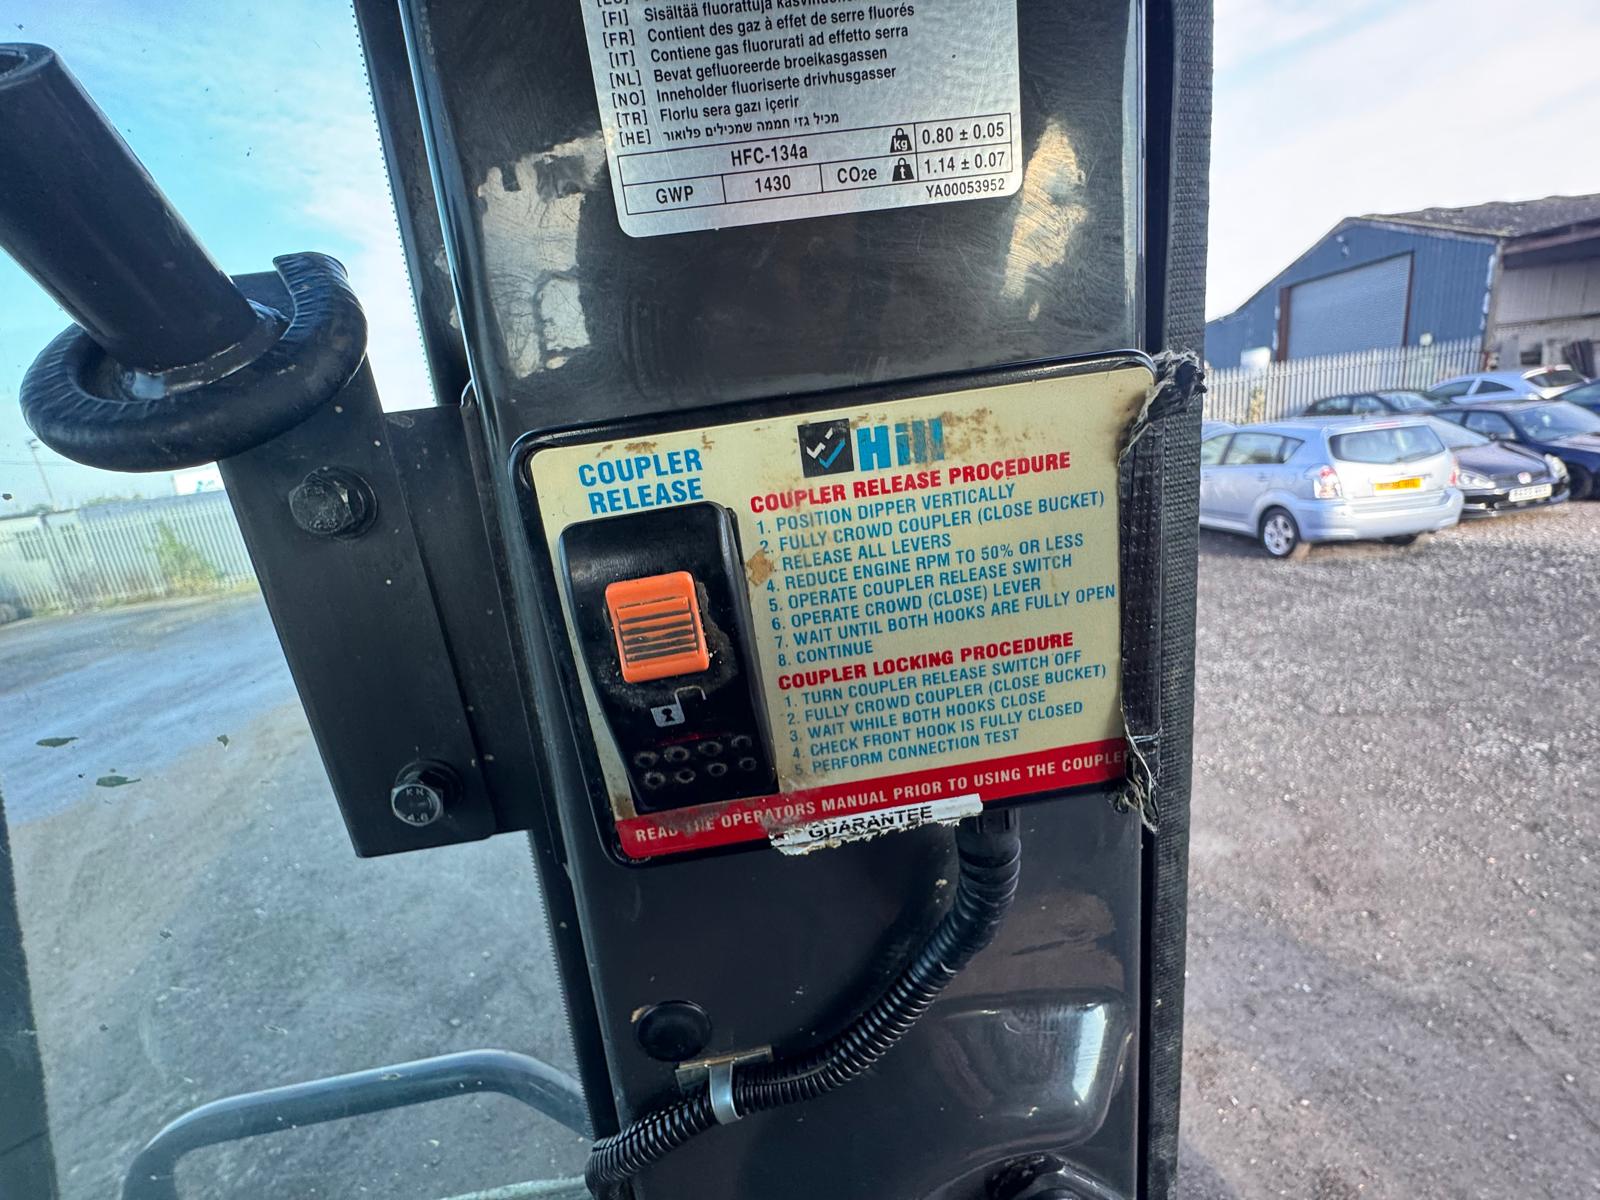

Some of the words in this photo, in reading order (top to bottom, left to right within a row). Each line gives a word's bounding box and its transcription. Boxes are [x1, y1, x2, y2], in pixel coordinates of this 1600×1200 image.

[601, 9, 629, 29] [FI]
[643, 2, 699, 22] Sisältää
[702, 0, 773, 16] fluorattuja
[602, 28, 635, 49] [FR]
[647, 23, 706, 43] Contient
[708, 20, 734, 37] des
[736, 20, 761, 37] gaz
[764, 15, 773, 31] à
[776, 12, 807, 30] effet
[810, 10, 827, 26] de
[830, 9, 865, 24] serre
[867, 1, 915, 20] fluorés
[608, 49, 636, 69] [IT]
[650, 45, 711, 63] Contiene
[714, 43, 739, 60] gas
[742, 32, 804, 54] fluorurati
[808, 30, 825, 47] ad
[828, 27, 871, 45] effetto
[874, 25, 908, 40] serra
[609, 69, 642, 89] [NL]
[653, 66, 693, 83] Bevat
[695, 56, 780, 82] gefluoreerde
[783, 48, 887, 69] broeikasgassen
[611, 89, 646, 109] [NO]
[656, 82, 728, 103] Inneholder
[730, 75, 800, 95] fluoriserte
[803, 67, 896, 87] drivhusgasser
[615, 108, 648, 129] [TR]
[659, 105, 699, 122] Florlu
[702, 104, 731, 118] sera
[764, 94, 799, 114] içerir
[922, 127, 954, 145] 0.80
[973, 122, 1005, 140] 0.05
[618, 128, 652, 148] [HE]
[731, 144, 808, 166] HFC-134a
[755, 174, 791, 193] 1430
[925, 157, 956, 175] 1.14
[974, 152, 1006, 169] 0.07
[656, 185, 694, 204] GWP
[926, 178, 1006, 198] YA00053952
[856, 416, 945, 472] Hill
[578, 448, 703, 488] COUPLER
[750, 484, 847, 513] COUPLER
[852, 470, 941, 499] RELEASE
[948, 451, 1071, 485] PROCEDURE
[588, 477, 704, 515] RELEASE
[756, 520, 771, 535] 1.
[775, 506, 852, 532] POSITION
[857, 497, 916, 520] DIPPER
[921, 482, 1015, 510] VERTICALLY
[779, 530, 827, 552] FULLY
[833, 521, 893, 544] CROWD
[898, 509, 972, 534] COUPLER
[977, 500, 1033, 525] (CLOSE
[1038, 490, 1105, 513] BUCKET)
[766, 579, 780, 593] 4.
[784, 567, 848, 590] REDUCE
[852, 557, 911, 580] ENGINE
[915, 551, 950, 571] RPM
[954, 548, 975, 564] TO
[981, 543, 1014, 561] 50%
[1018, 538, 1040, 555] OR
[1045, 532, 1083, 551] LESS
[782, 548, 853, 571] RELEASE
[858, 542, 887, 560] ALL
[891, 532, 951, 555] LEVERS
[768, 597, 783, 612] 5.
[787, 585, 858, 609] OPERATE
[862, 573, 934, 598] COUPLER
[939, 562, 1007, 586] RELEASE
[1012, 553, 1072, 575] SWITCH
[771, 616, 786, 631] 6.
[790, 604, 860, 628] OPERATE
[864, 595, 922, 617] CROWD
[928, 584, 988, 610] (CLOSE)
[993, 576, 1041, 597] LEVER
[774, 634, 788, 649] 7.
[792, 627, 832, 646] WAIT
[837, 620, 883, 640] UNTIL
[887, 612, 928, 632] BOTH
[933, 604, 985, 625] HOOKS
[990, 598, 1020, 616] ARE
[1024, 590, 1070, 611] FULLY
[1075, 583, 1116, 603] OPEN
[777, 653, 791, 667] 8.
[795, 639, 874, 664] CONTINUE
[777, 663, 867, 690] COUPLER
[872, 649, 954, 676] LOCKING
[960, 631, 1073, 663] PROCEDURE
[784, 695, 797, 708] 1.
[801, 687, 843, 705] TURN
[847, 675, 918, 698] COUPLER
[921, 664, 987, 687] RELEASE
[991, 655, 1049, 676] SWITCH
[1053, 649, 1081, 666] OFF
[786, 712, 800, 725] 2.
[804, 703, 849, 722] FULLY
[854, 694, 910, 715] CROWD
[914, 682, 983, 705] COUPLER
[988, 673, 1040, 696] (CLOSE
[1044, 663, 1106, 685] BUCKET)
[807, 721, 844, 739] WAIT
[849, 713, 897, 733] WHILE
[902, 706, 941, 725] BOTH
[945, 697, 996, 718] HOOKS
[1000, 689, 1046, 709] CLOSE
[809, 736, 858, 757] CHECK
[862, 728, 911, 747] FRONT
[916, 721, 956, 740] HOOK
[960, 718, 975, 732] IS
[979, 710, 1022, 729] FULLY
[1027, 701, 1083, 721] CLOSED
[812, 750, 883, 773] PERFORM
[887, 734, 980, 761] CONNECTION
[983, 727, 1019, 744] TEST
[635, 822, 678, 842] READ
[684, 815, 715, 835] HE
[721, 801, 816, 829] OPERATORS
[821, 794, 888, 812] MANUAL
[892, 781, 942, 800] PRIOR
[948, 776, 968, 792] TO
[974, 767, 1021, 788] USING
[1026, 761, 1056, 778] THE
[809, 805, 933, 839] GUARANTEE
